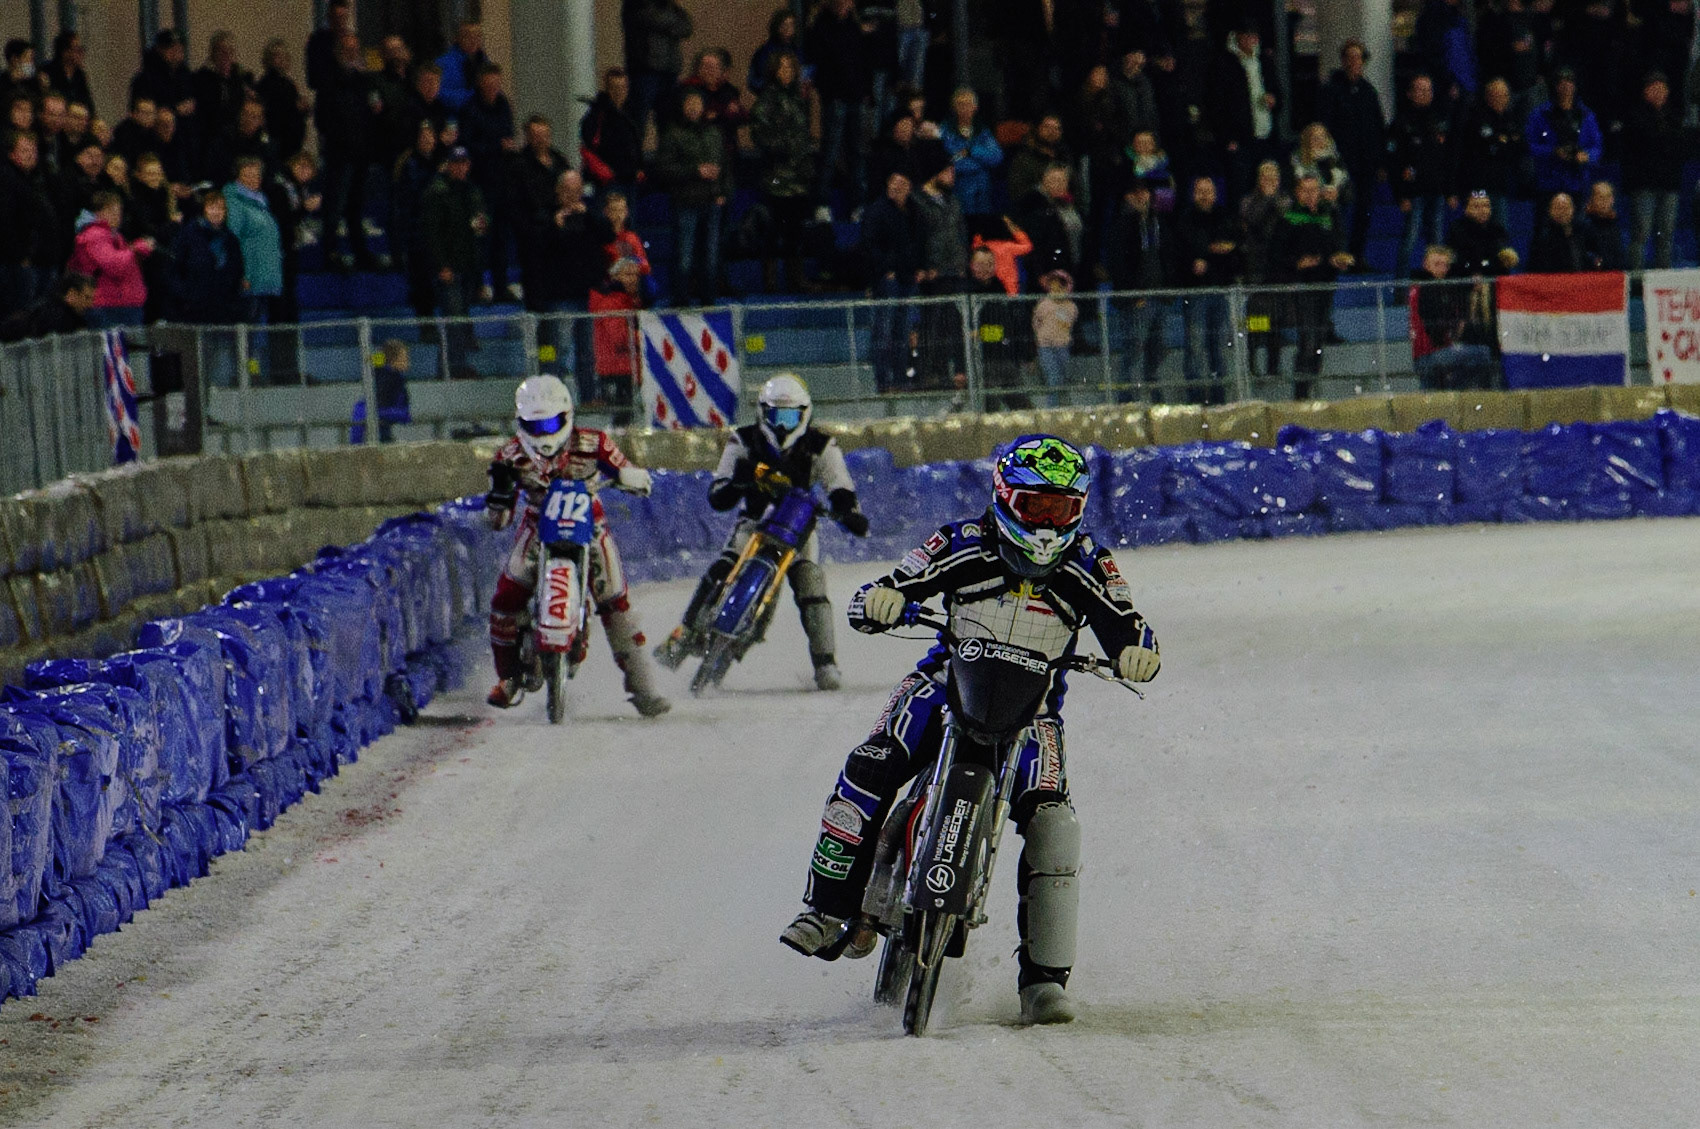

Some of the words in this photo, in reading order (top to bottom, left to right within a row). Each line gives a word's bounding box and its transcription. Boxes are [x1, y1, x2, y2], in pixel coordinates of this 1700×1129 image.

[545, 490, 588, 523] 412
[549, 567, 570, 620] AVIA
[984, 648, 1049, 672] LAGEDER
[933, 815, 952, 861] Installationen
[941, 798, 967, 864] LAGEDER
[813, 851, 830, 868] OCK
[831, 863, 849, 872] OIL
